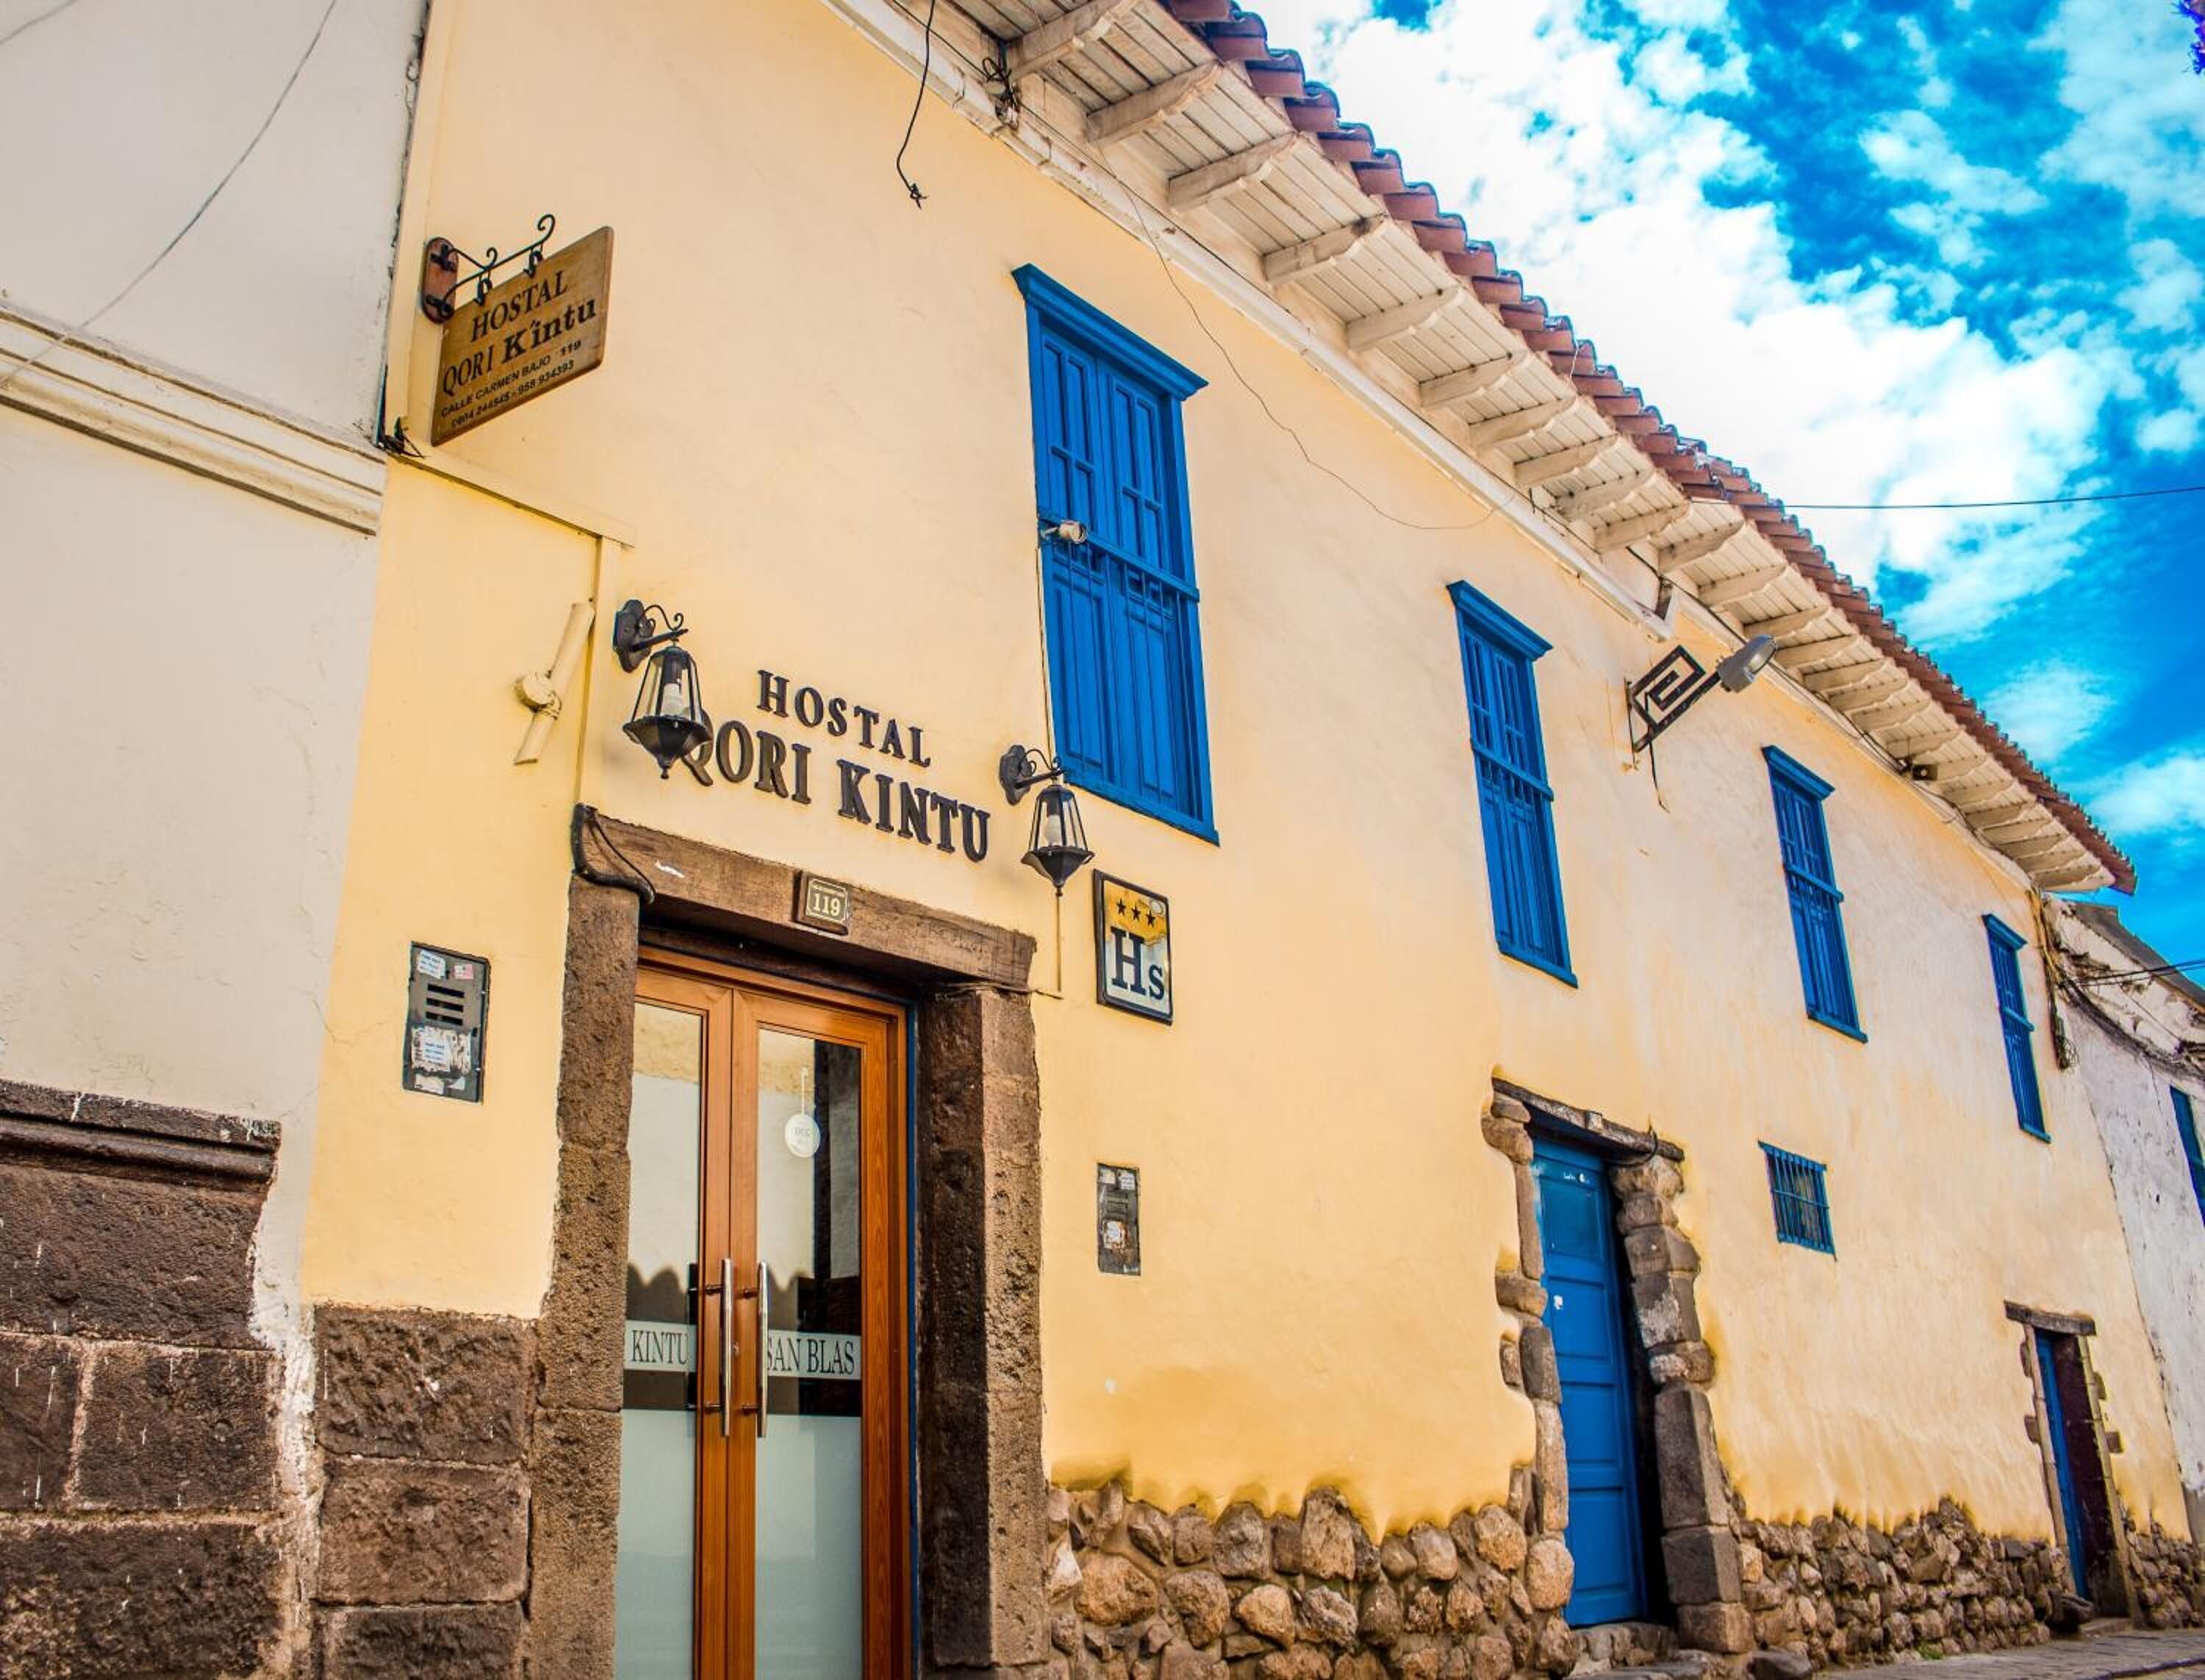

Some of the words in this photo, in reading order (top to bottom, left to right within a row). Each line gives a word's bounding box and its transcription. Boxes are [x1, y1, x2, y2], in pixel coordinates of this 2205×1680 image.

[470, 270, 567, 342] HOSTAL
[441, 394, 474, 417] CALLE
[476, 370, 519, 400] CARMEN
[522, 355, 551, 377] BAJO
[561, 340, 581, 356] 119
[442, 345, 493, 397] QORI
[756, 670, 931, 767] HOSTAL
[836, 758, 990, 863] KINTU
[813, 893, 840, 916] 119
[632, 1329, 689, 1365] KINTU
[807, 1338, 855, 1375] BLAS
